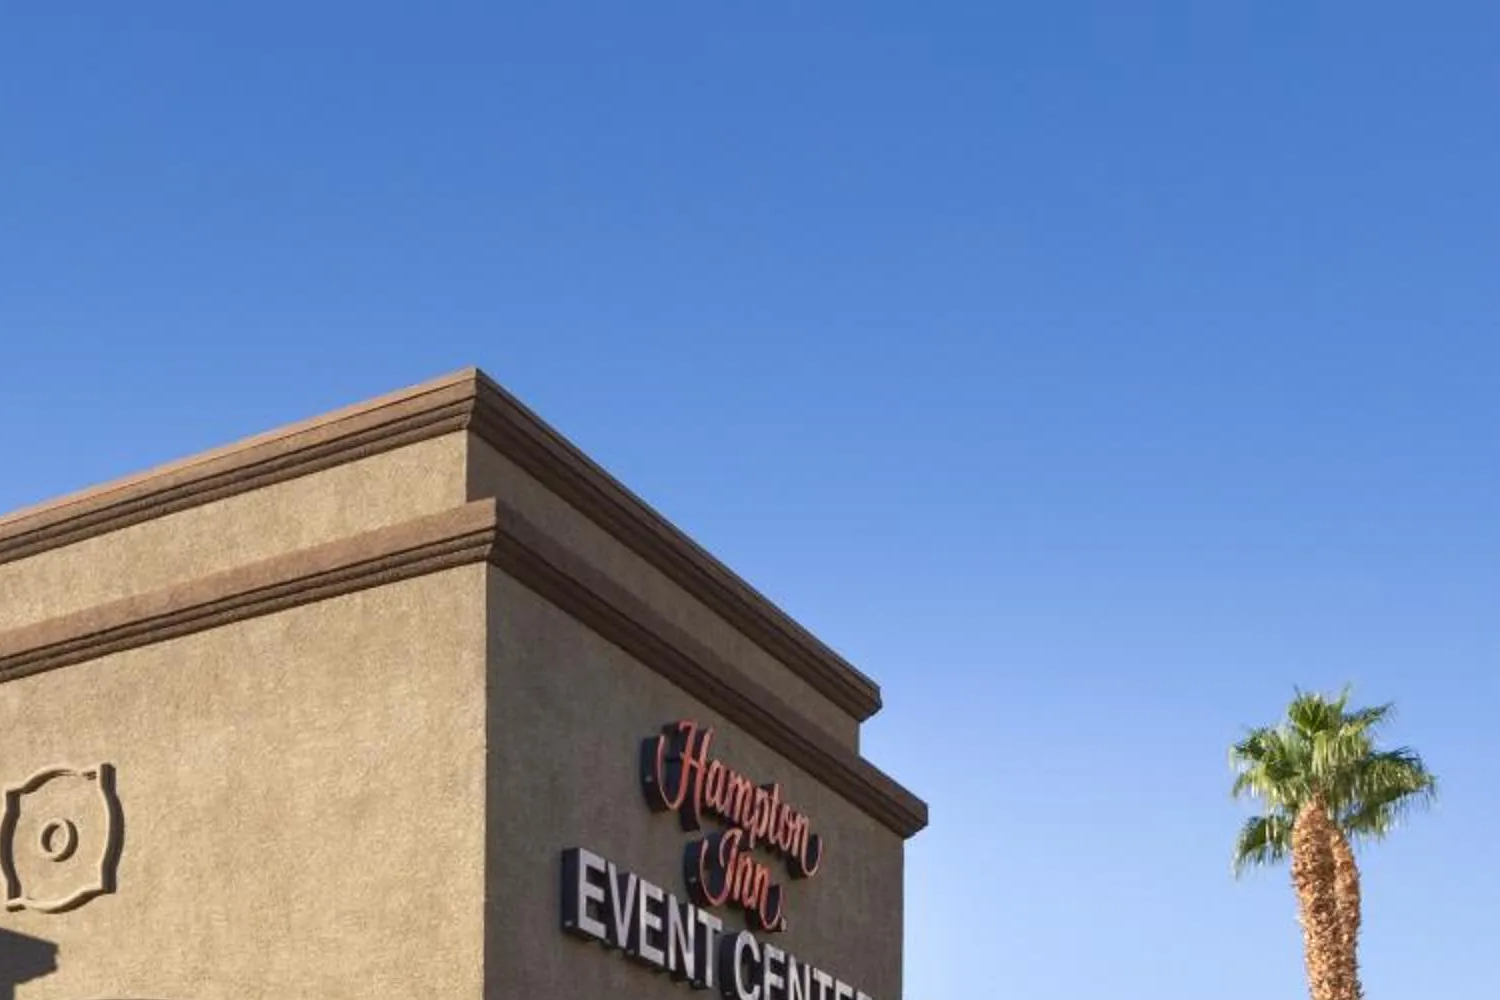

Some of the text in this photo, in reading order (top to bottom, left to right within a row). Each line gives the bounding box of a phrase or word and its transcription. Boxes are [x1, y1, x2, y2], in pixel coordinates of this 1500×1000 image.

[656, 719, 823, 877] Hampton
[577, 848, 722, 988] EVENT
[699, 828, 784, 930] Inn
